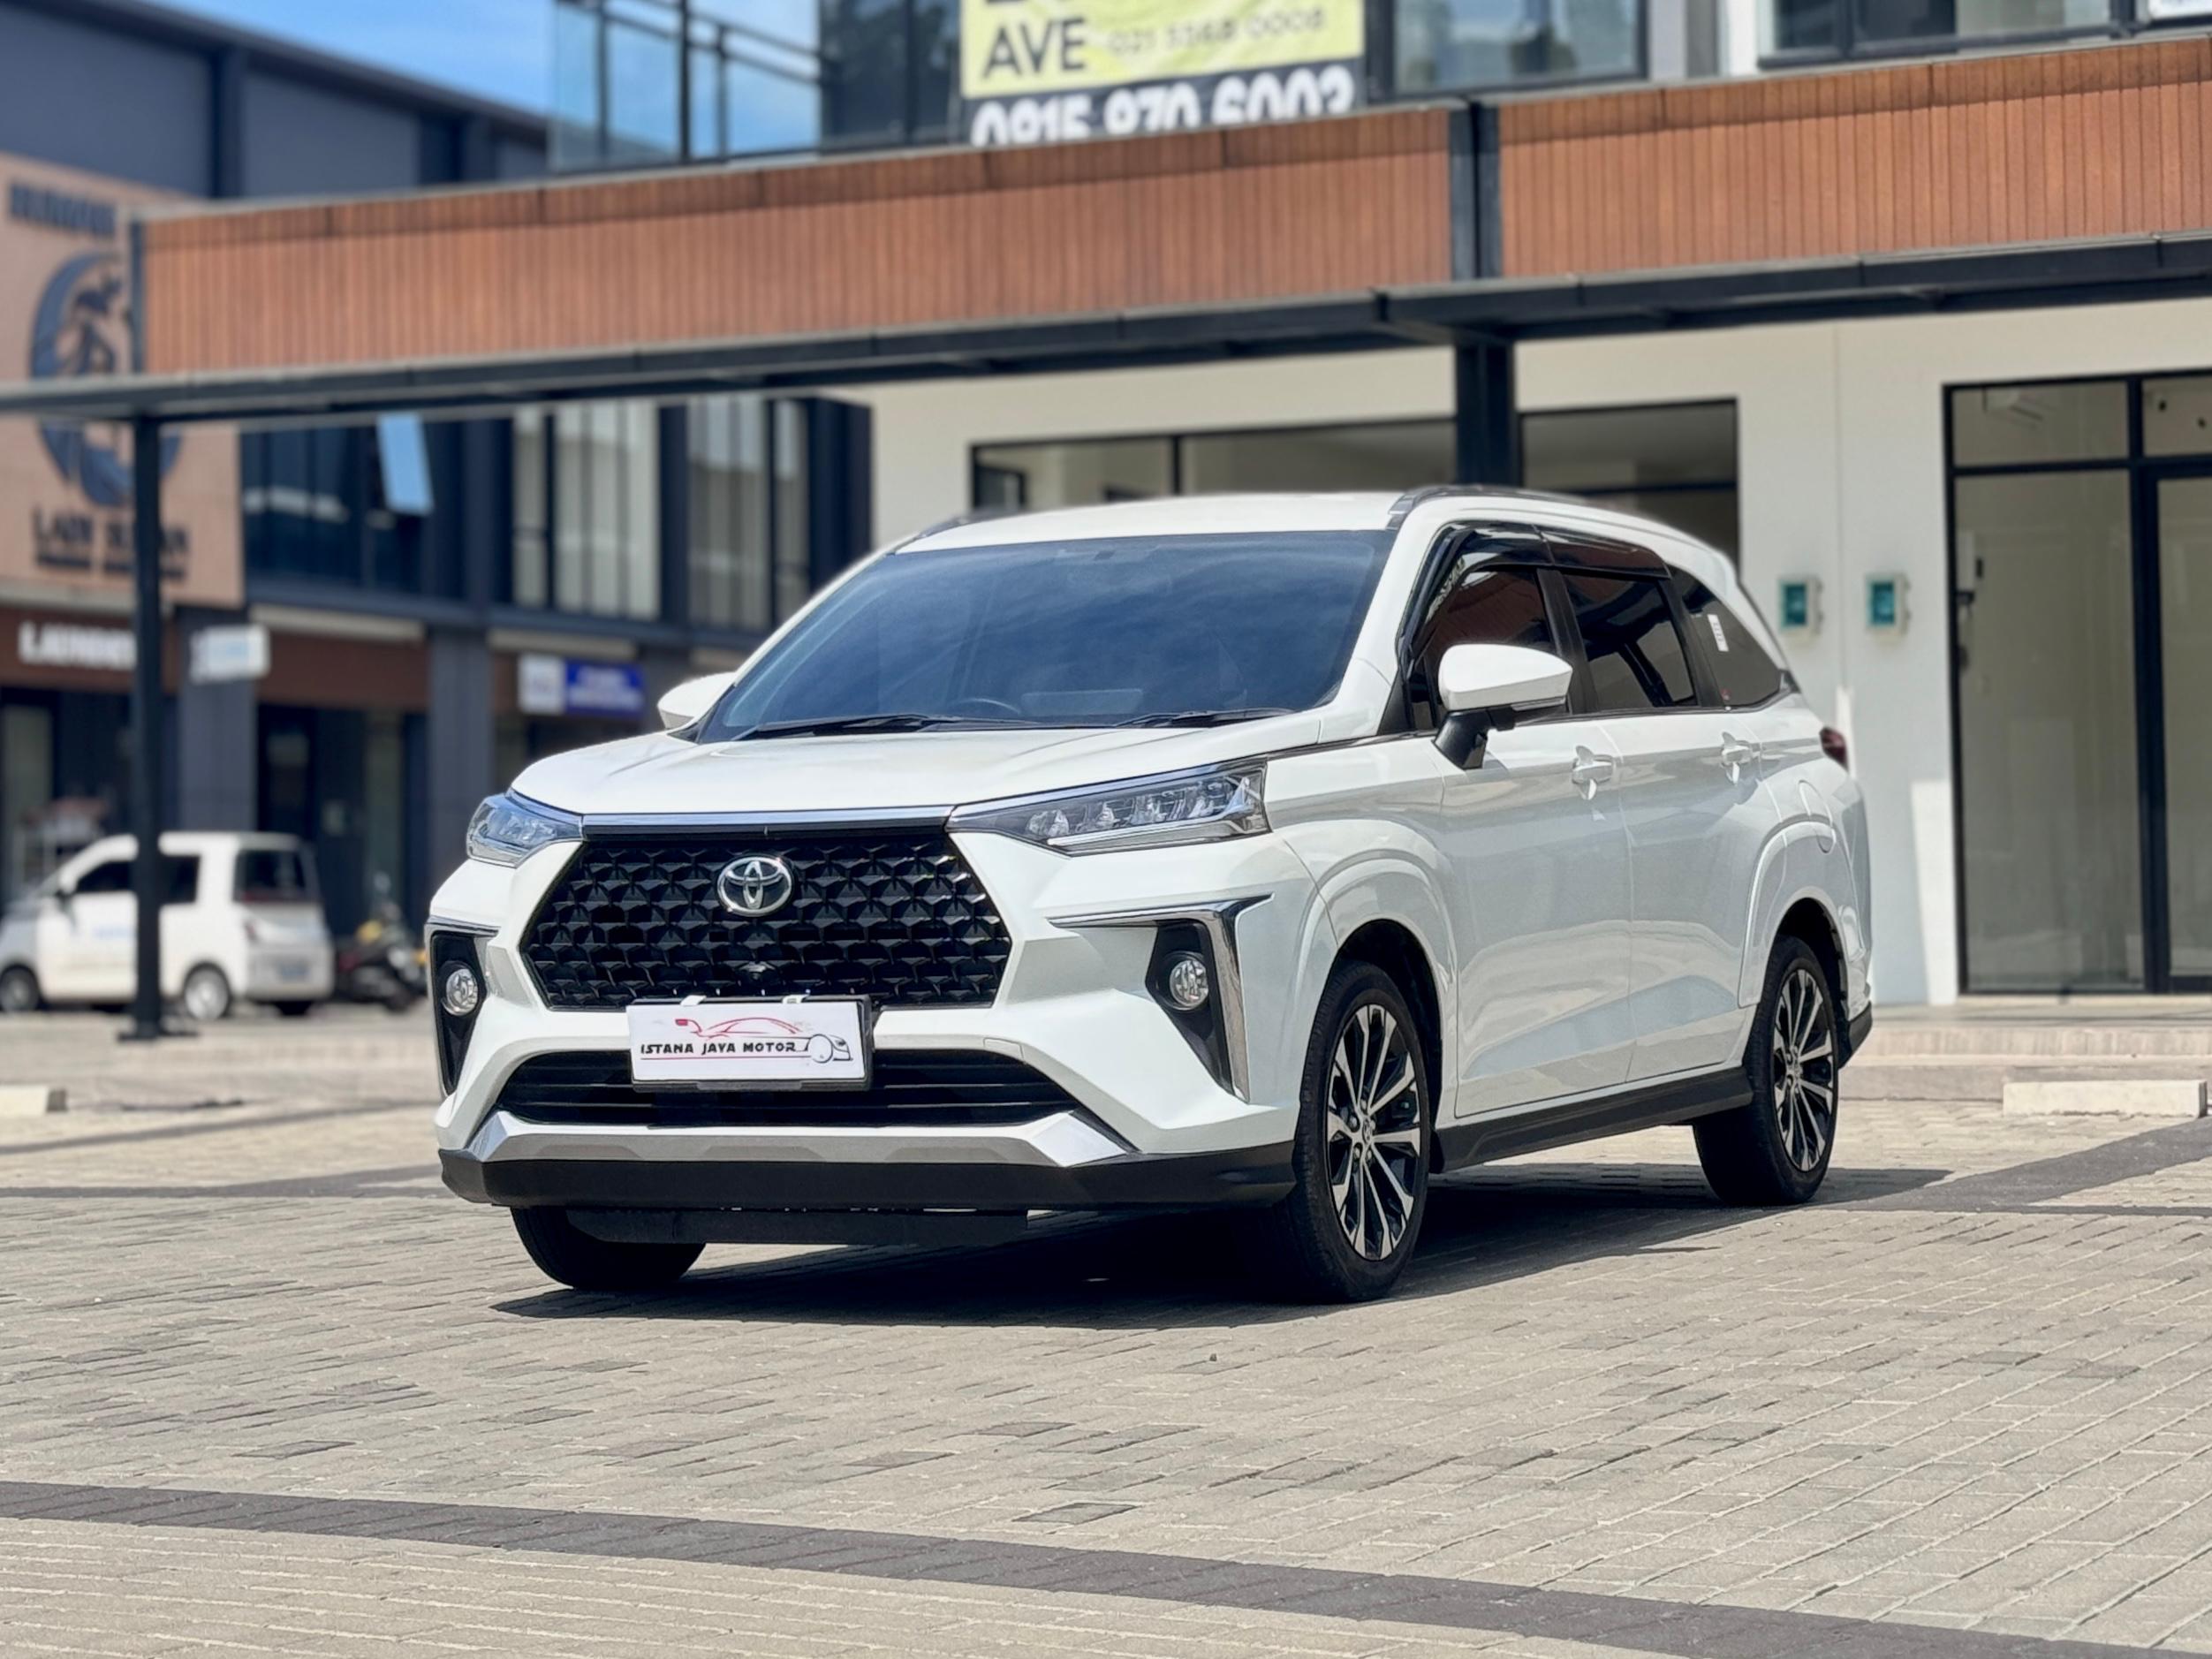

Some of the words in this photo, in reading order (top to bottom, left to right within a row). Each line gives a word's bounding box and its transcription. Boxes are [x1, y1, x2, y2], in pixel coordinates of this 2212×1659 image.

[981, 18, 1086, 79] AVE
[640, 1043, 694, 1054] ISTANA
[701, 1042, 736, 1056] JAYA
[743, 1042, 796, 1053] MOTOR
